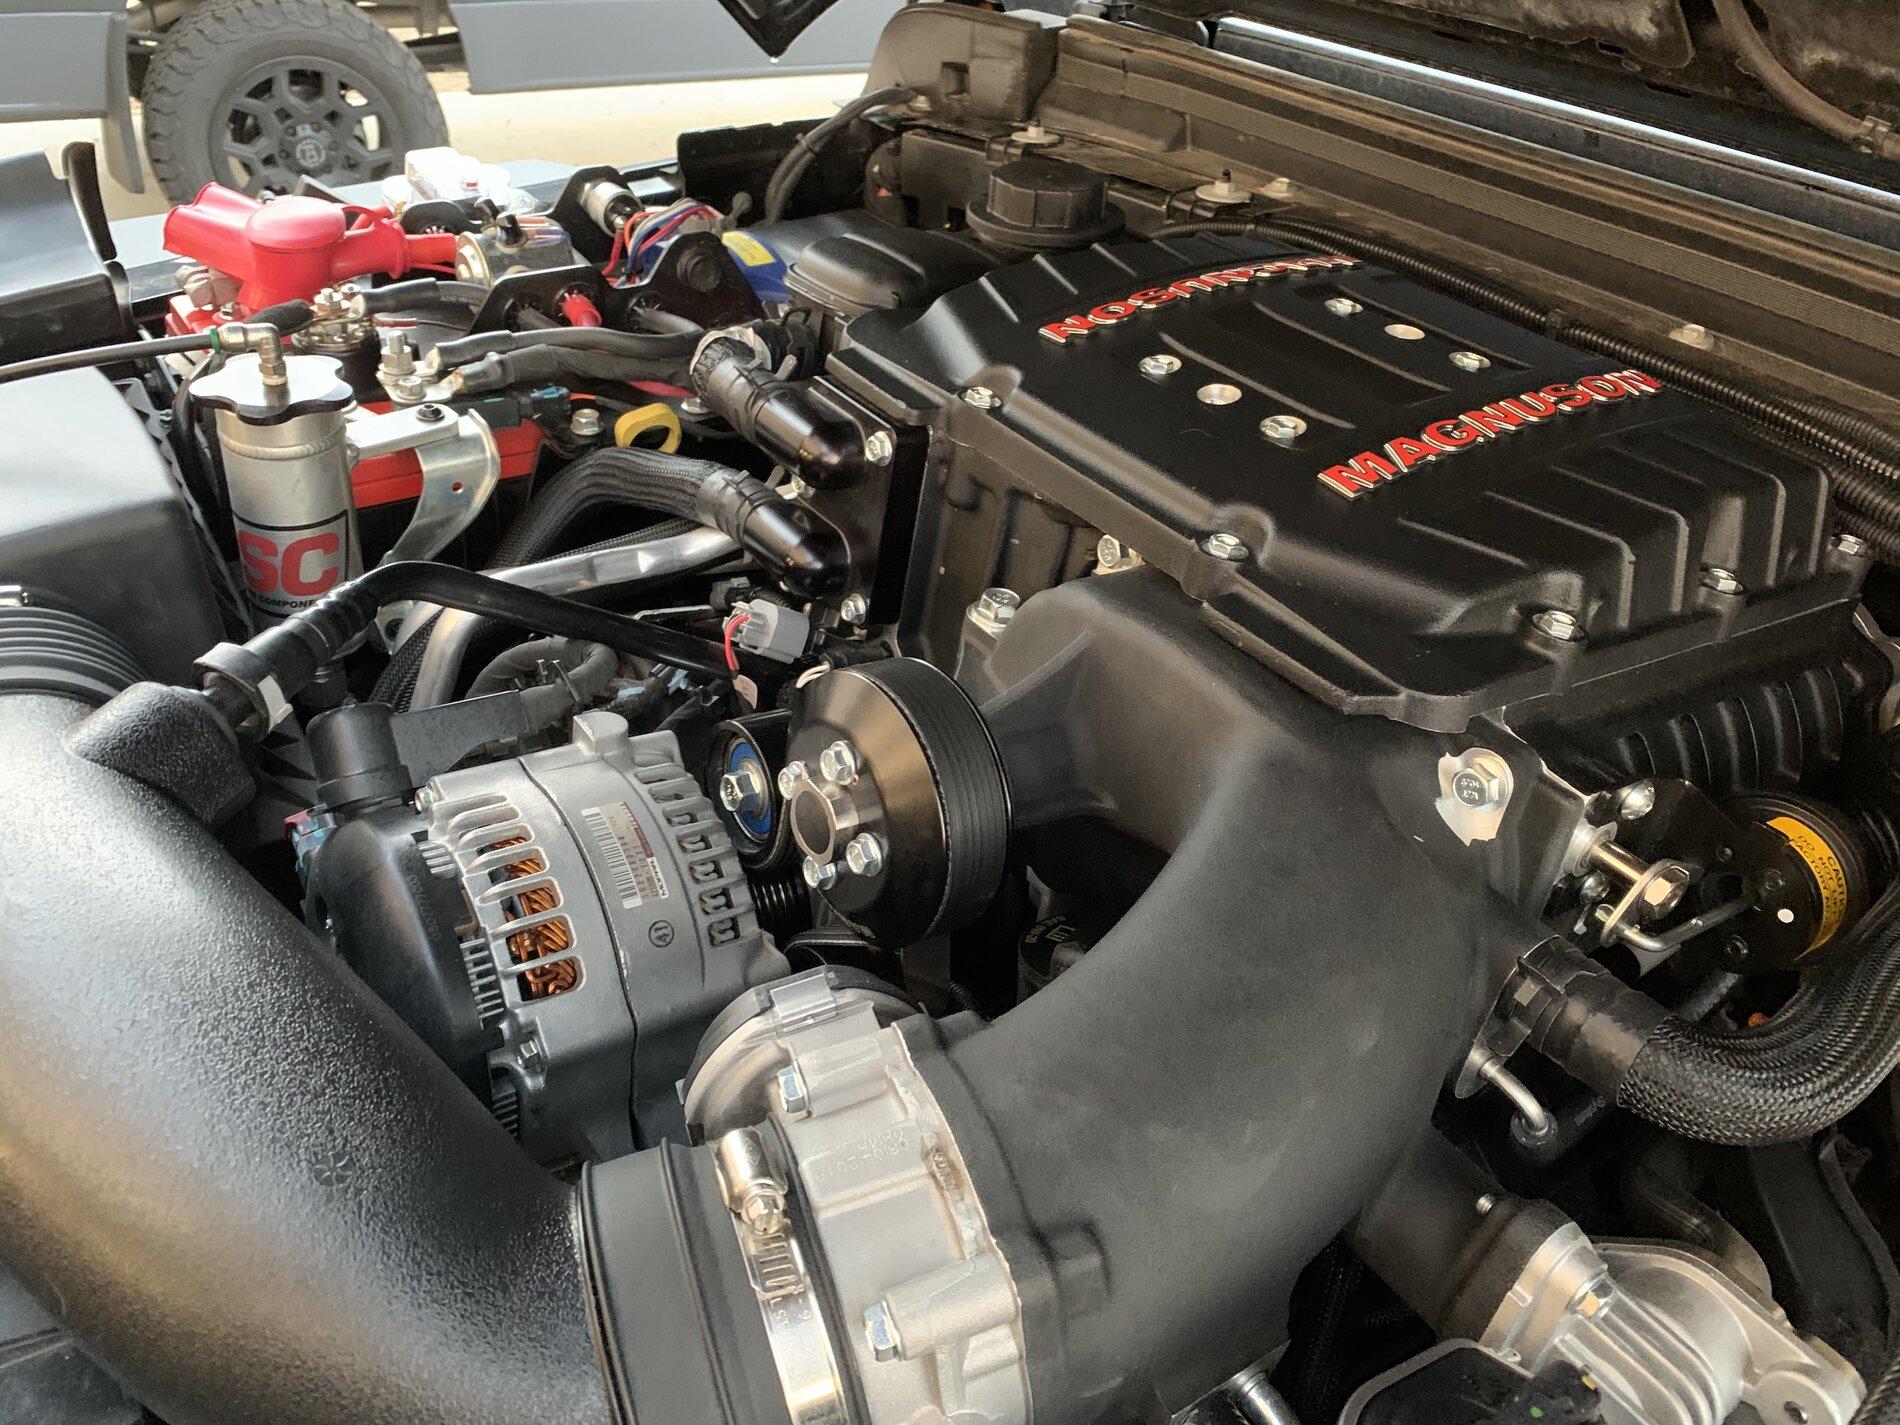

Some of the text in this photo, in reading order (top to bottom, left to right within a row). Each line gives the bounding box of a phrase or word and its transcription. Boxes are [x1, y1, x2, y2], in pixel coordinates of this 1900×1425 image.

[1038, 254, 1360, 344] MAGNUSON
[1316, 369, 1662, 499] MAGNUSON
[238, 529, 340, 597] SC
[1798, 835, 1815, 851] DO
[1818, 856, 1834, 881] NOT
